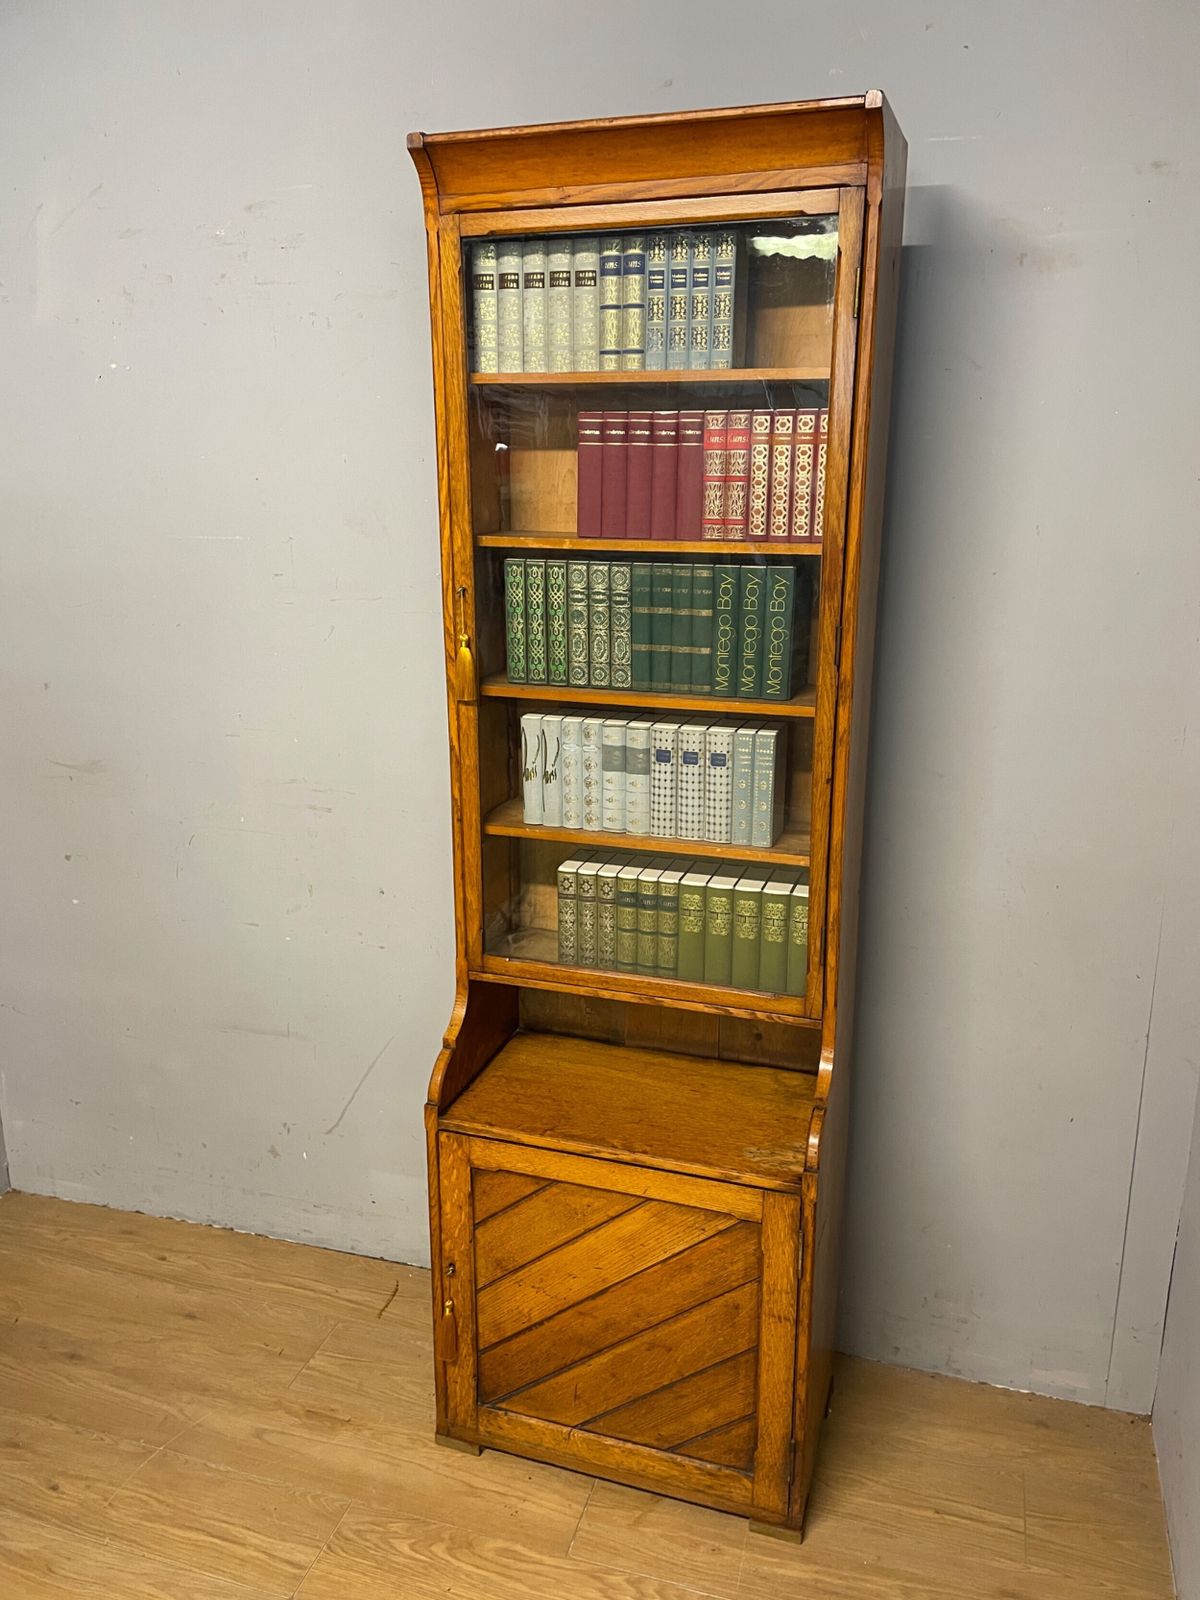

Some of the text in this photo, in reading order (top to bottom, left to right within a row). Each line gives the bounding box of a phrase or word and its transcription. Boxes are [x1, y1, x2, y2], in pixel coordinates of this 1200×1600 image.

[715, 573, 736, 691] Montego Bay
[741, 573, 763, 692] Montego Bay
[766, 574, 791, 694] Montego Bay
